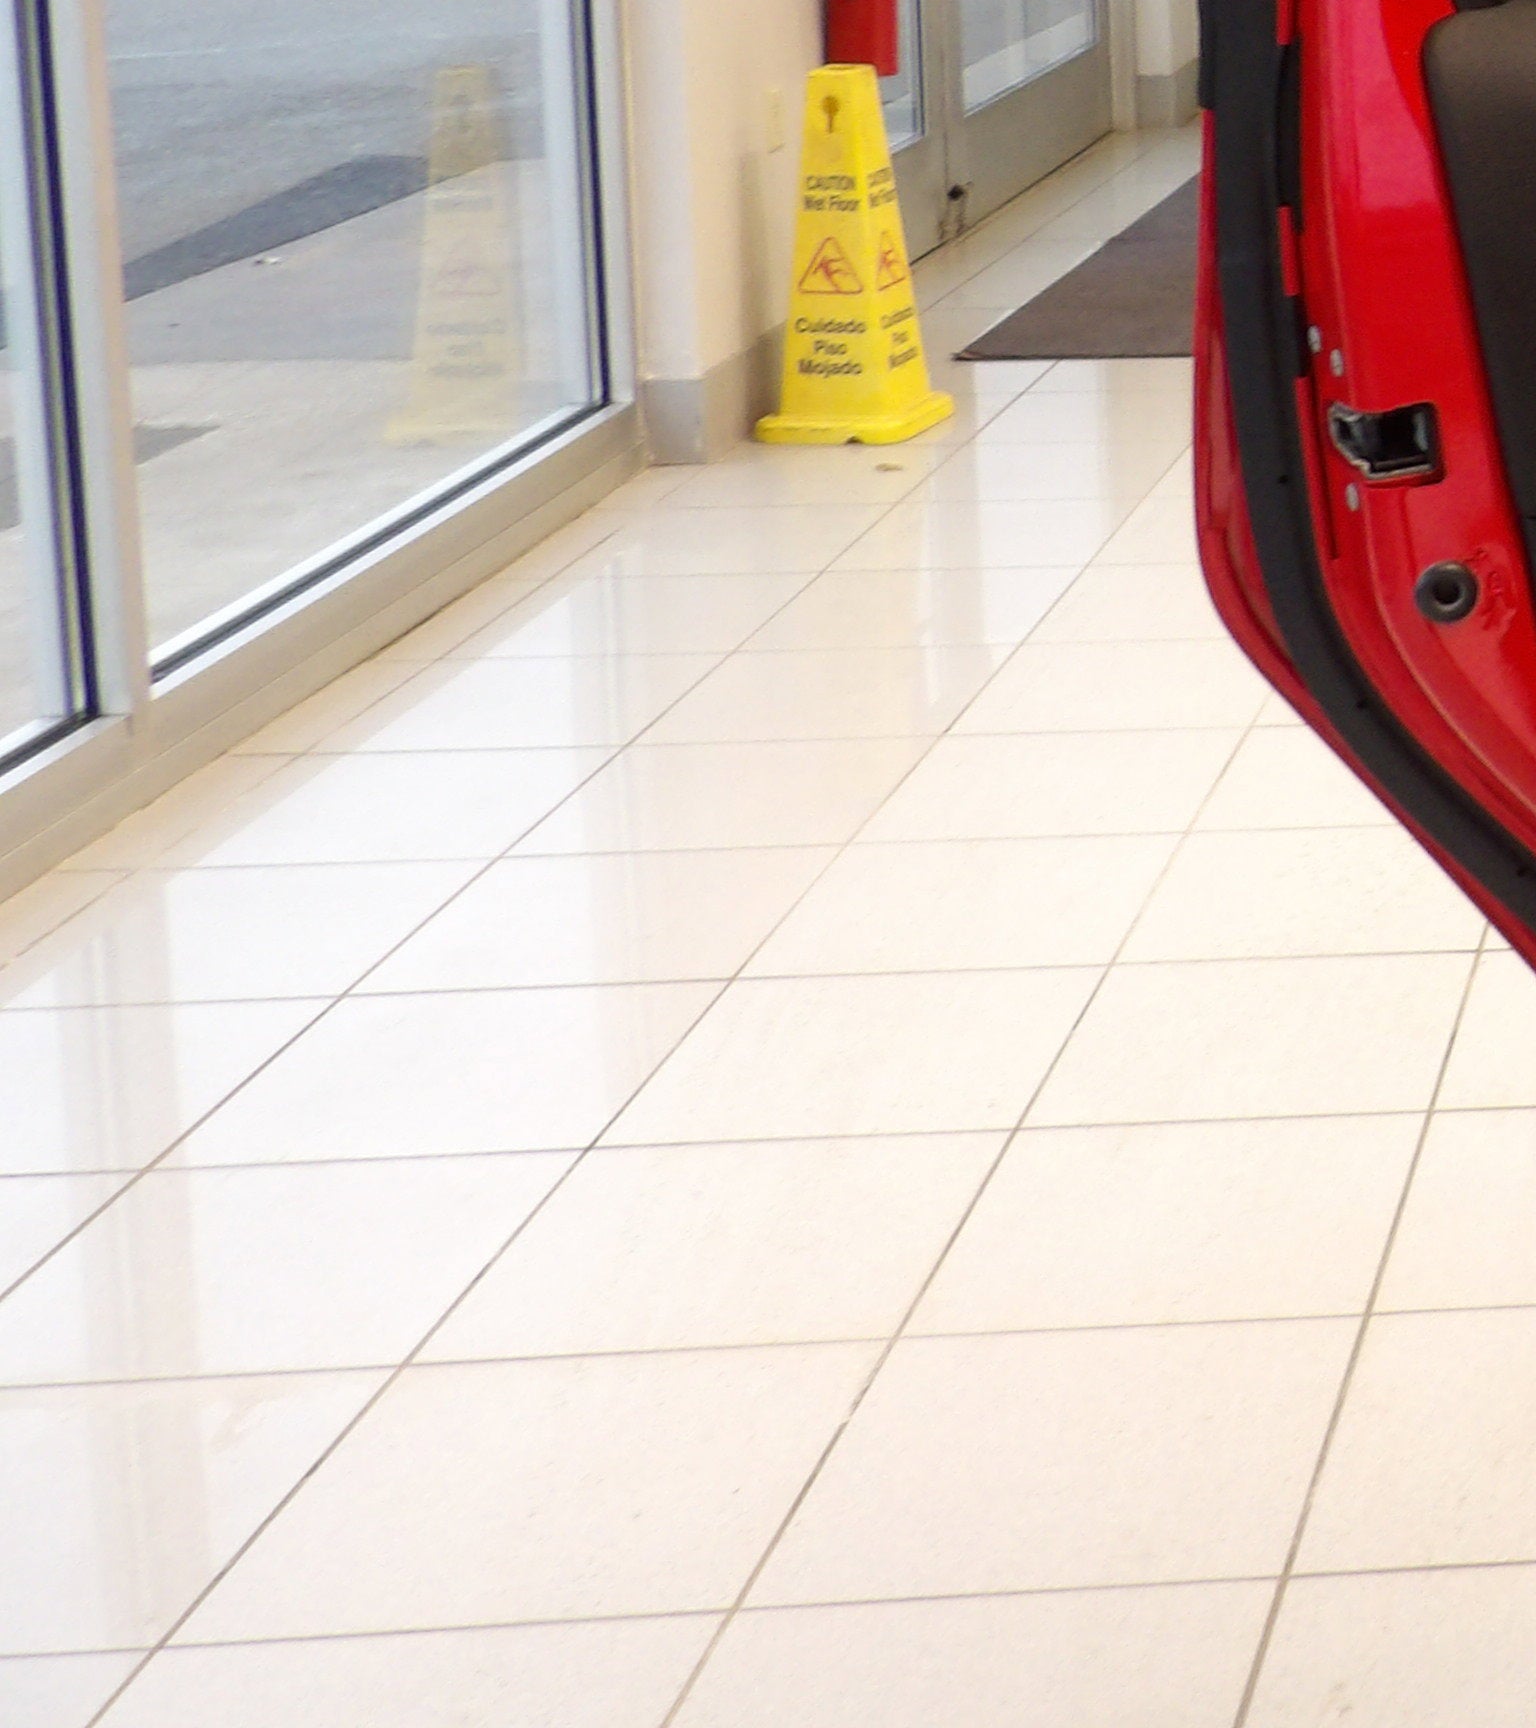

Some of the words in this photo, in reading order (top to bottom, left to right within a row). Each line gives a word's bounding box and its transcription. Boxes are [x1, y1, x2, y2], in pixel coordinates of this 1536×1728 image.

[805, 175, 856, 190] CAUTION
[804, 195, 825, 211] Wet
[829, 194, 860, 211] Floor
[794, 316, 867, 333] Cuidado
[814, 339, 848, 355] Piso
[798, 358, 863, 378] Mojado
